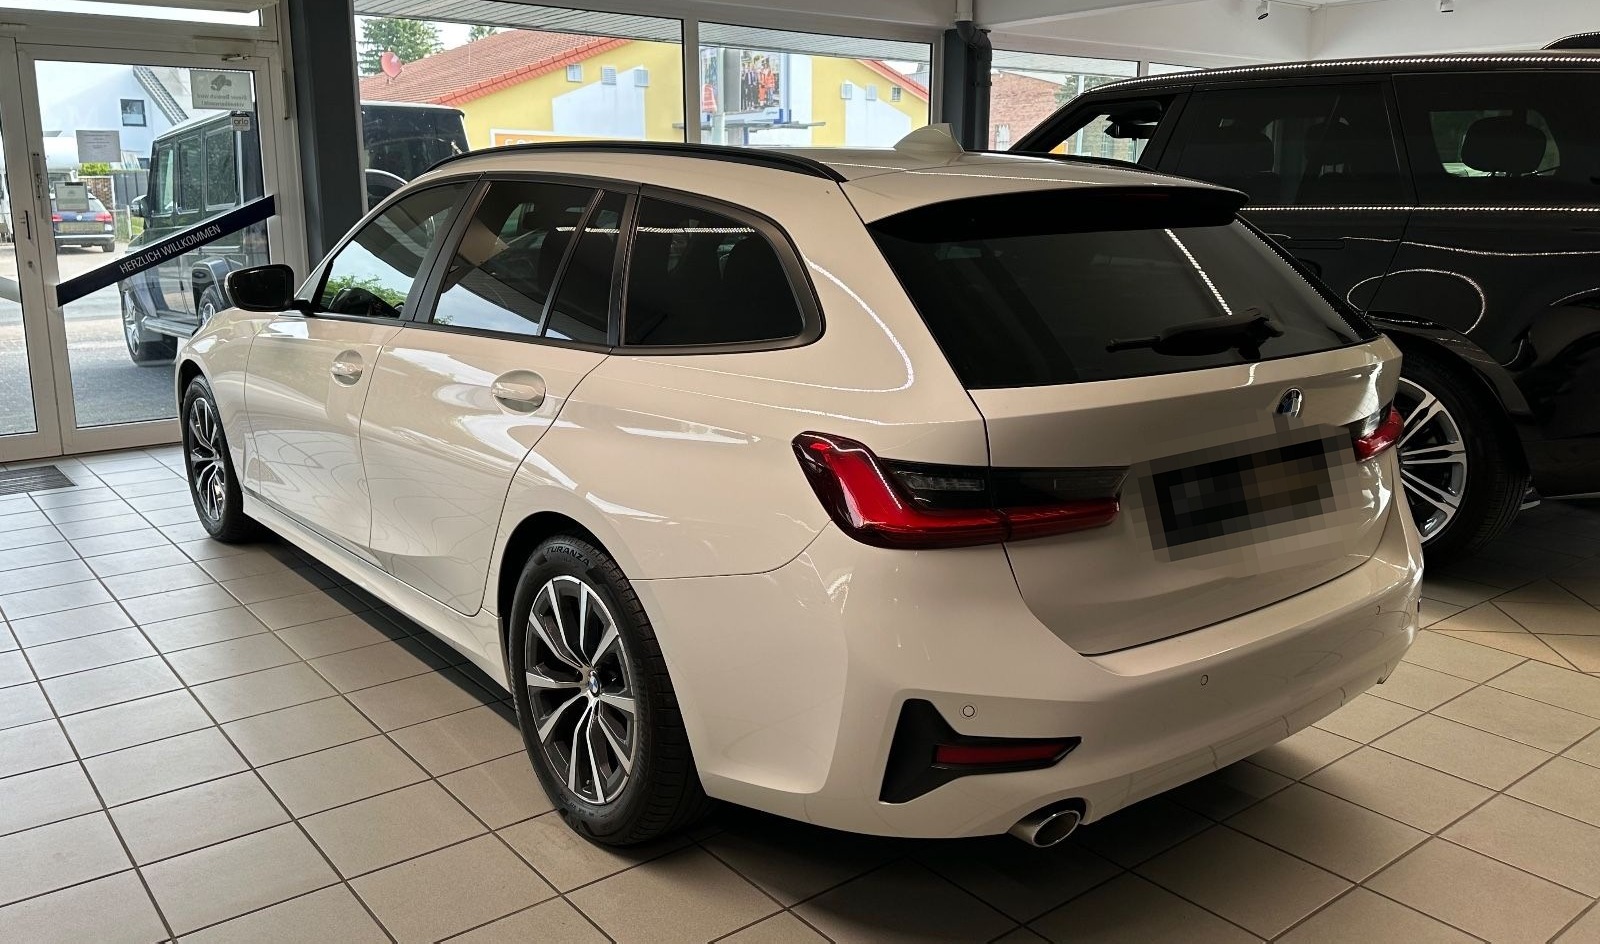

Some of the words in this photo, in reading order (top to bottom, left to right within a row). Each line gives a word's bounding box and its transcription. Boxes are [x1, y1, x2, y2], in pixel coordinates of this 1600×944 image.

[119, 249, 162, 274] HERZLICH
[160, 224, 221, 256] WILLKOMMEN
[546, 545, 590, 567] TURANZA
